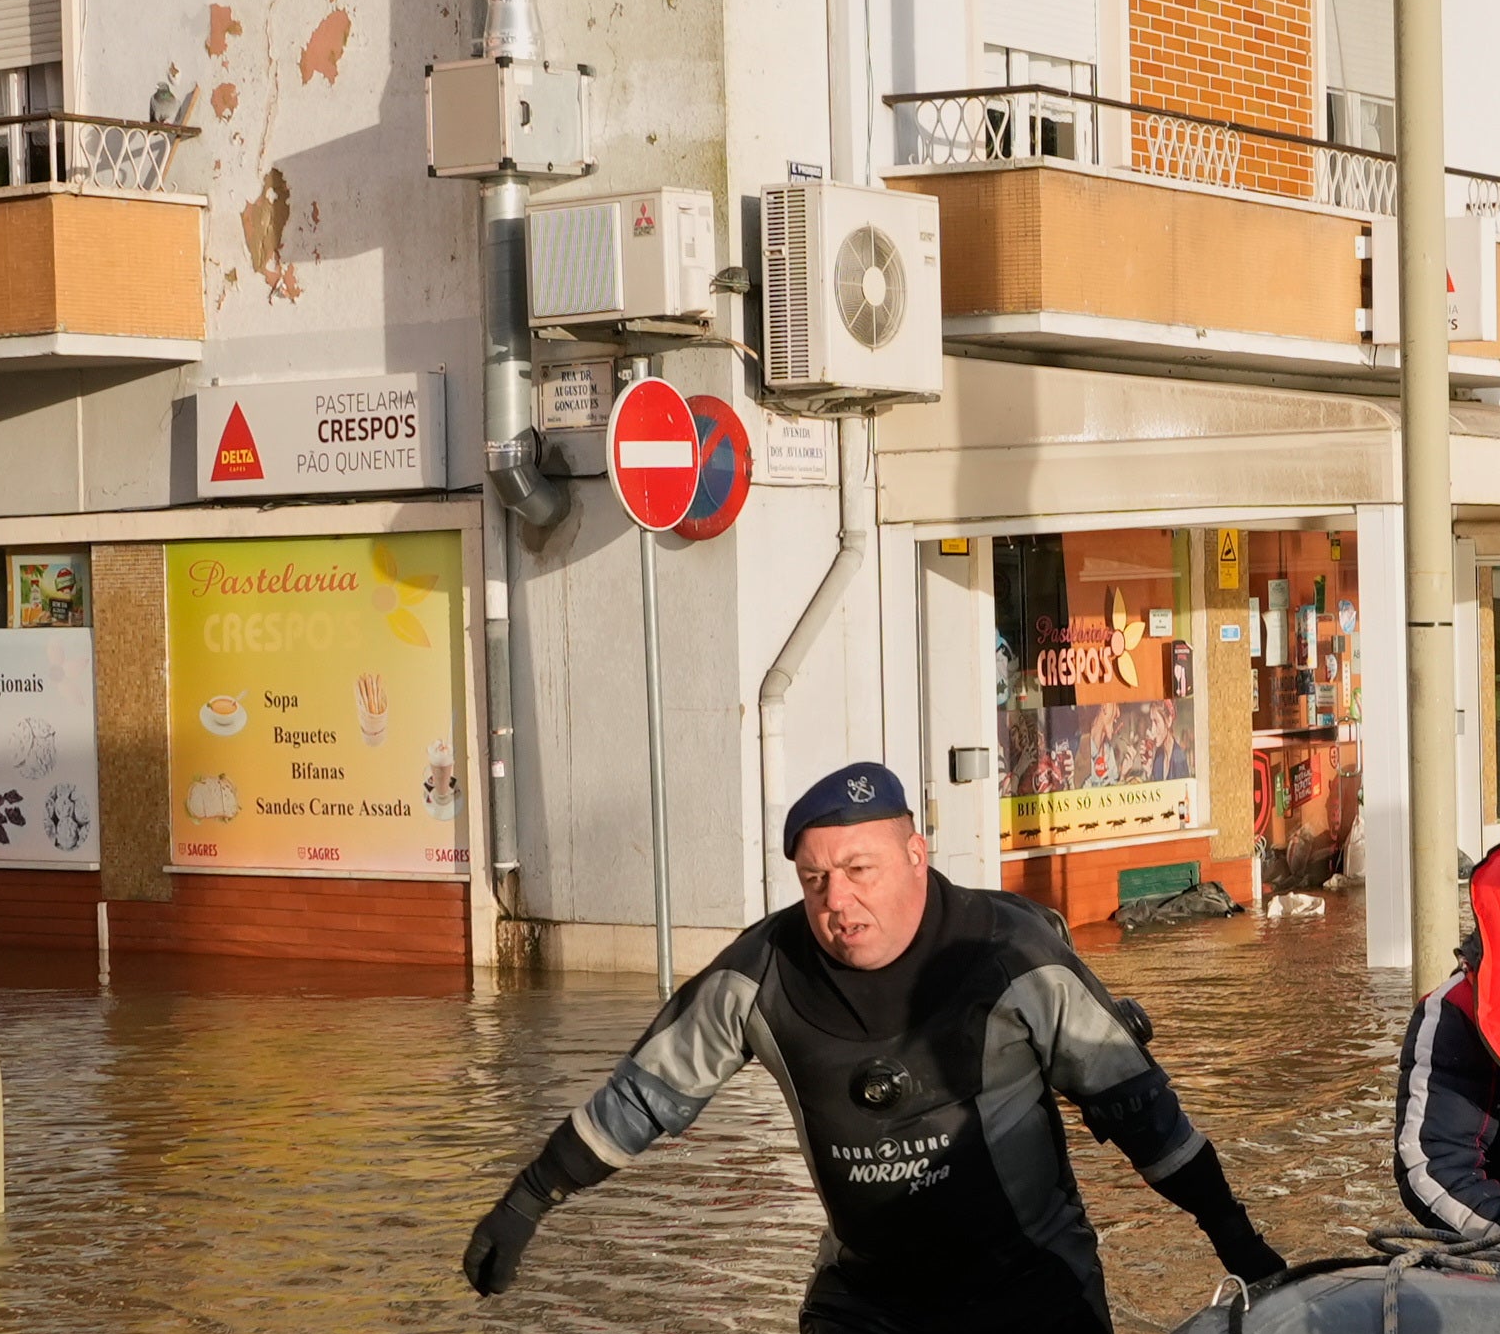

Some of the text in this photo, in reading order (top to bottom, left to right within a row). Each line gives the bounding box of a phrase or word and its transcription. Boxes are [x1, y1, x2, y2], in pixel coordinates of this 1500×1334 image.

[561, 370, 577, 382] RUA
[555, 384, 588, 397] AUGUSTO
[316, 390, 416, 415] PASTELARIA
[555, 398, 599, 413] GONÇALVES
[318, 414, 416, 443] CRESPO'S
[783, 426, 811, 439] AVENIDA
[221, 449, 255, 465] DELTA
[297, 448, 416, 475] PÃO QUNENTE
[771, 446, 824, 459] DOS AVIADORES
[189, 559, 359, 598] Pastelaria
[203, 611, 365, 654] CRESPO'S
[1036, 615, 1114, 645] Pastelaria
[1037, 646, 1114, 687] CRESPO'S
[264, 690, 299, 715] Sopa
[273, 726, 337, 748] Baguetes
[291, 762, 345, 781] Bifanas
[256, 797, 411, 817] Sandes Carne Assada
[1017, 787, 1162, 817] BIFANAS SÓ AS NOSSAS
[187, 843, 218, 857] SAGRES
[307, 847, 340, 861] SAGRES
[436, 848, 470, 862] SAGRES
[832, 1134, 950, 1160] AQUA LUNG
[848, 1157, 930, 1184] NORDIC
